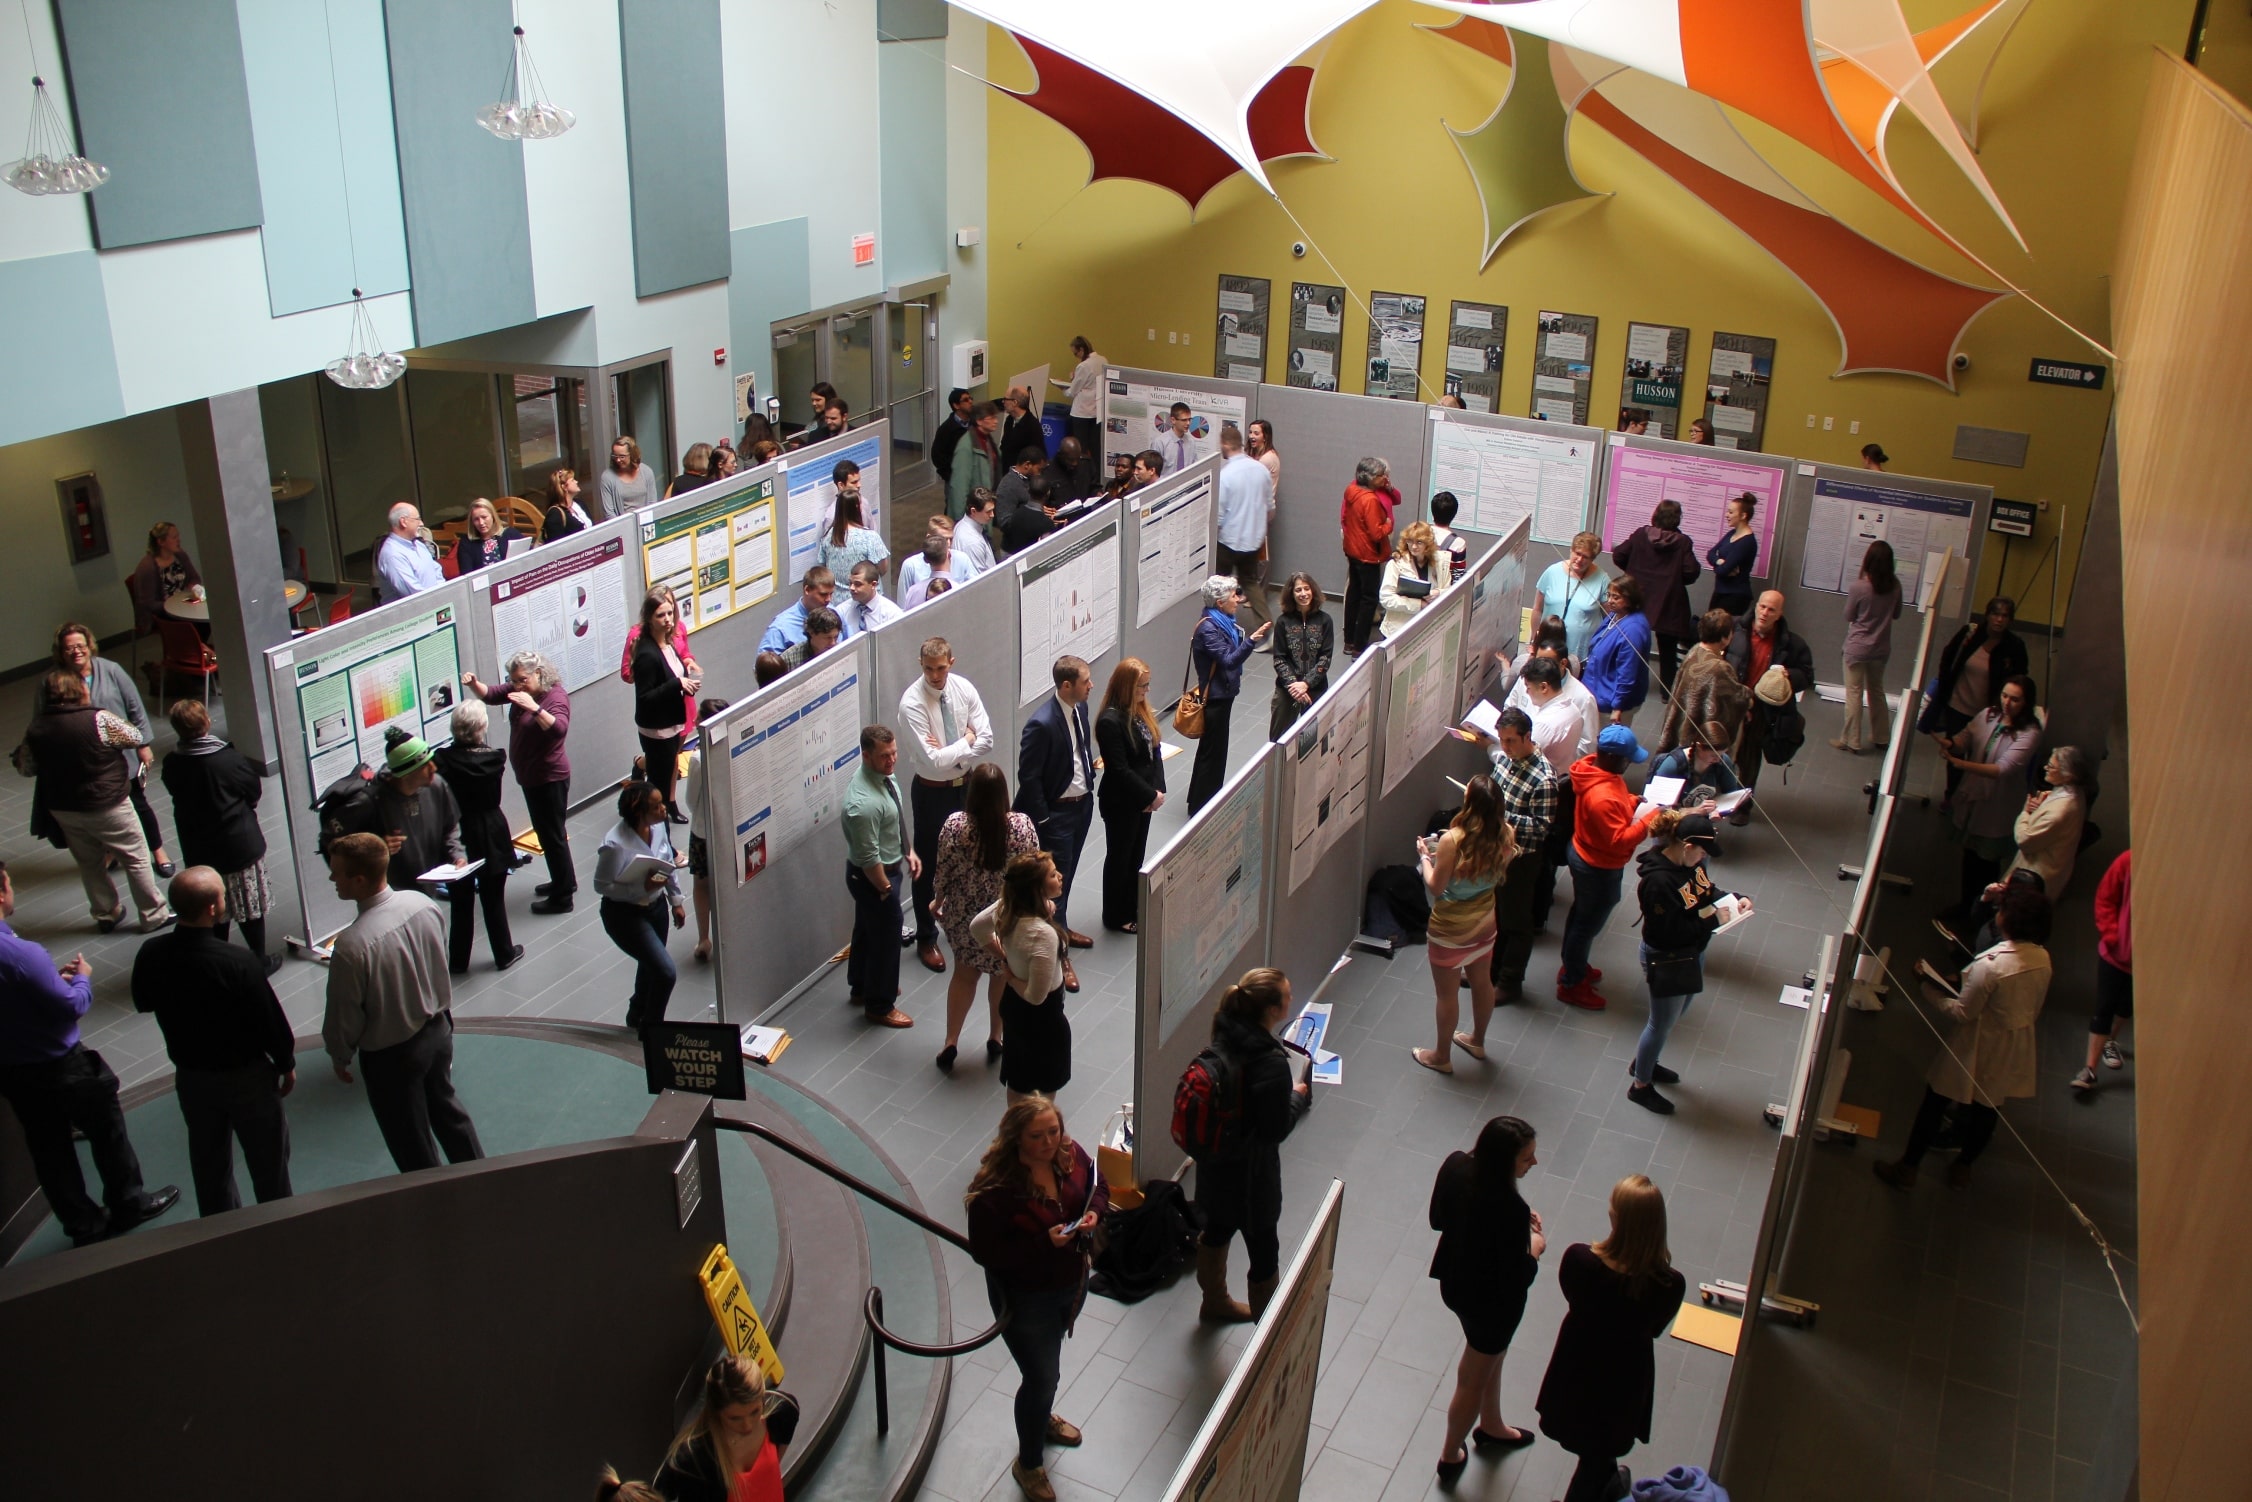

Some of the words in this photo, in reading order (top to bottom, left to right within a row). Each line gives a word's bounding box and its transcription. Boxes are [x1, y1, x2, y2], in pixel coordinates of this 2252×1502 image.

[857, 246, 872, 262] EXIT
[1311, 338, 1335, 352] 1953
[1455, 334, 1482, 348] 1977
[1536, 361, 1567, 377] 2005
[2037, 365, 2081, 380] ELEVATOR
[1289, 374, 1312, 387] 1961
[1175, 387, 1203, 397] University
[1466, 382, 1493, 396] 1980
[1636, 383, 1676, 398] HUSSON
[1150, 392, 1191, 404] Micro-Lending
[1192, 397, 1207, 406] Team
[1574, 394, 1586, 424] 2007
[2009, 508, 2030, 519] OFFICE
[528, 571, 537, 579] Pain
[548, 561, 558, 571] Daily
[557, 555, 581, 567] Occupations
[318, 655, 330, 664] Light
[329, 652, 341, 660] Color
[349, 641, 366, 651] Intensity
[366, 631, 390, 644] Preferences
[390, 626, 404, 638] Among
[404, 620, 419, 632] College
[299, 663, 317, 675] HUSSON
[674, 1033, 710, 1048] Please
[664, 1047, 722, 1063] WATCH
[672, 1062, 718, 1075] YOUR
[674, 1075, 717, 1088] STEP
[722, 1282, 741, 1313] CAUTION
